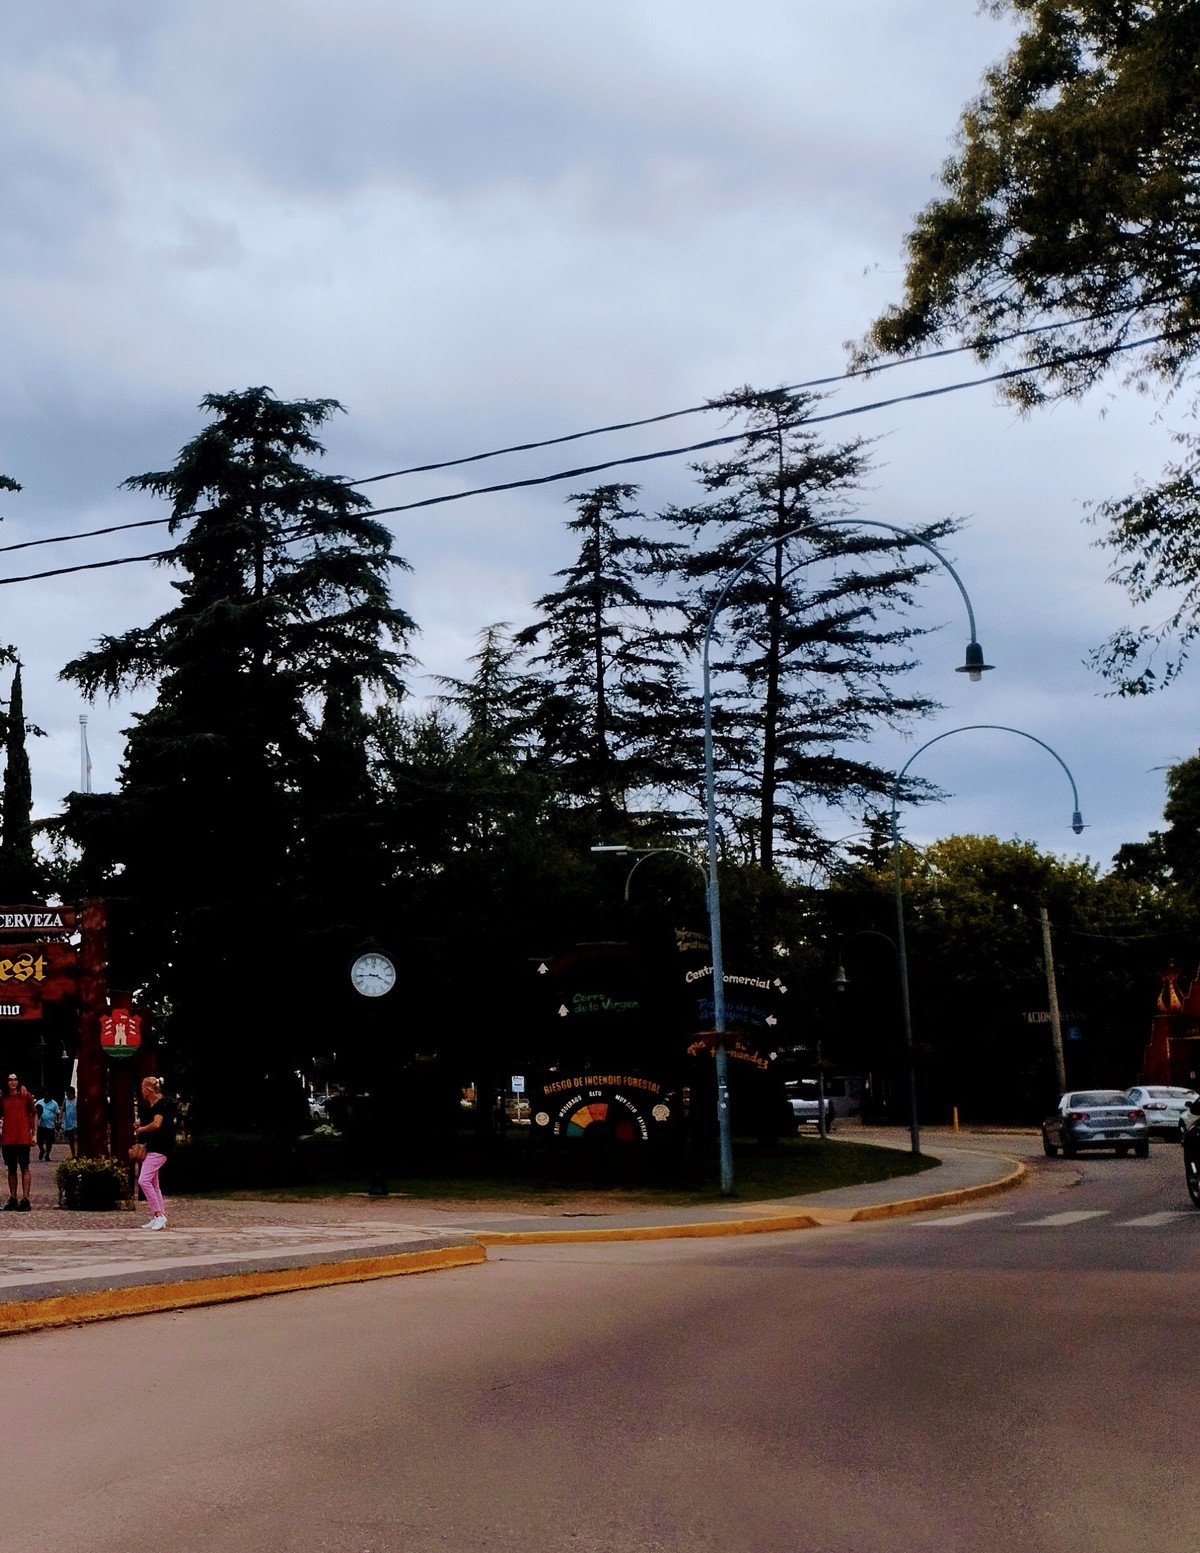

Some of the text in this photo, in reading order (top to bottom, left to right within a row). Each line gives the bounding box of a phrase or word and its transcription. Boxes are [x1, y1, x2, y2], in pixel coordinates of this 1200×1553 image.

[685, 965, 770, 989] Centr omercial
[543, 1075, 661, 1095] RIESGO DE INCENDIO FORESTAL
